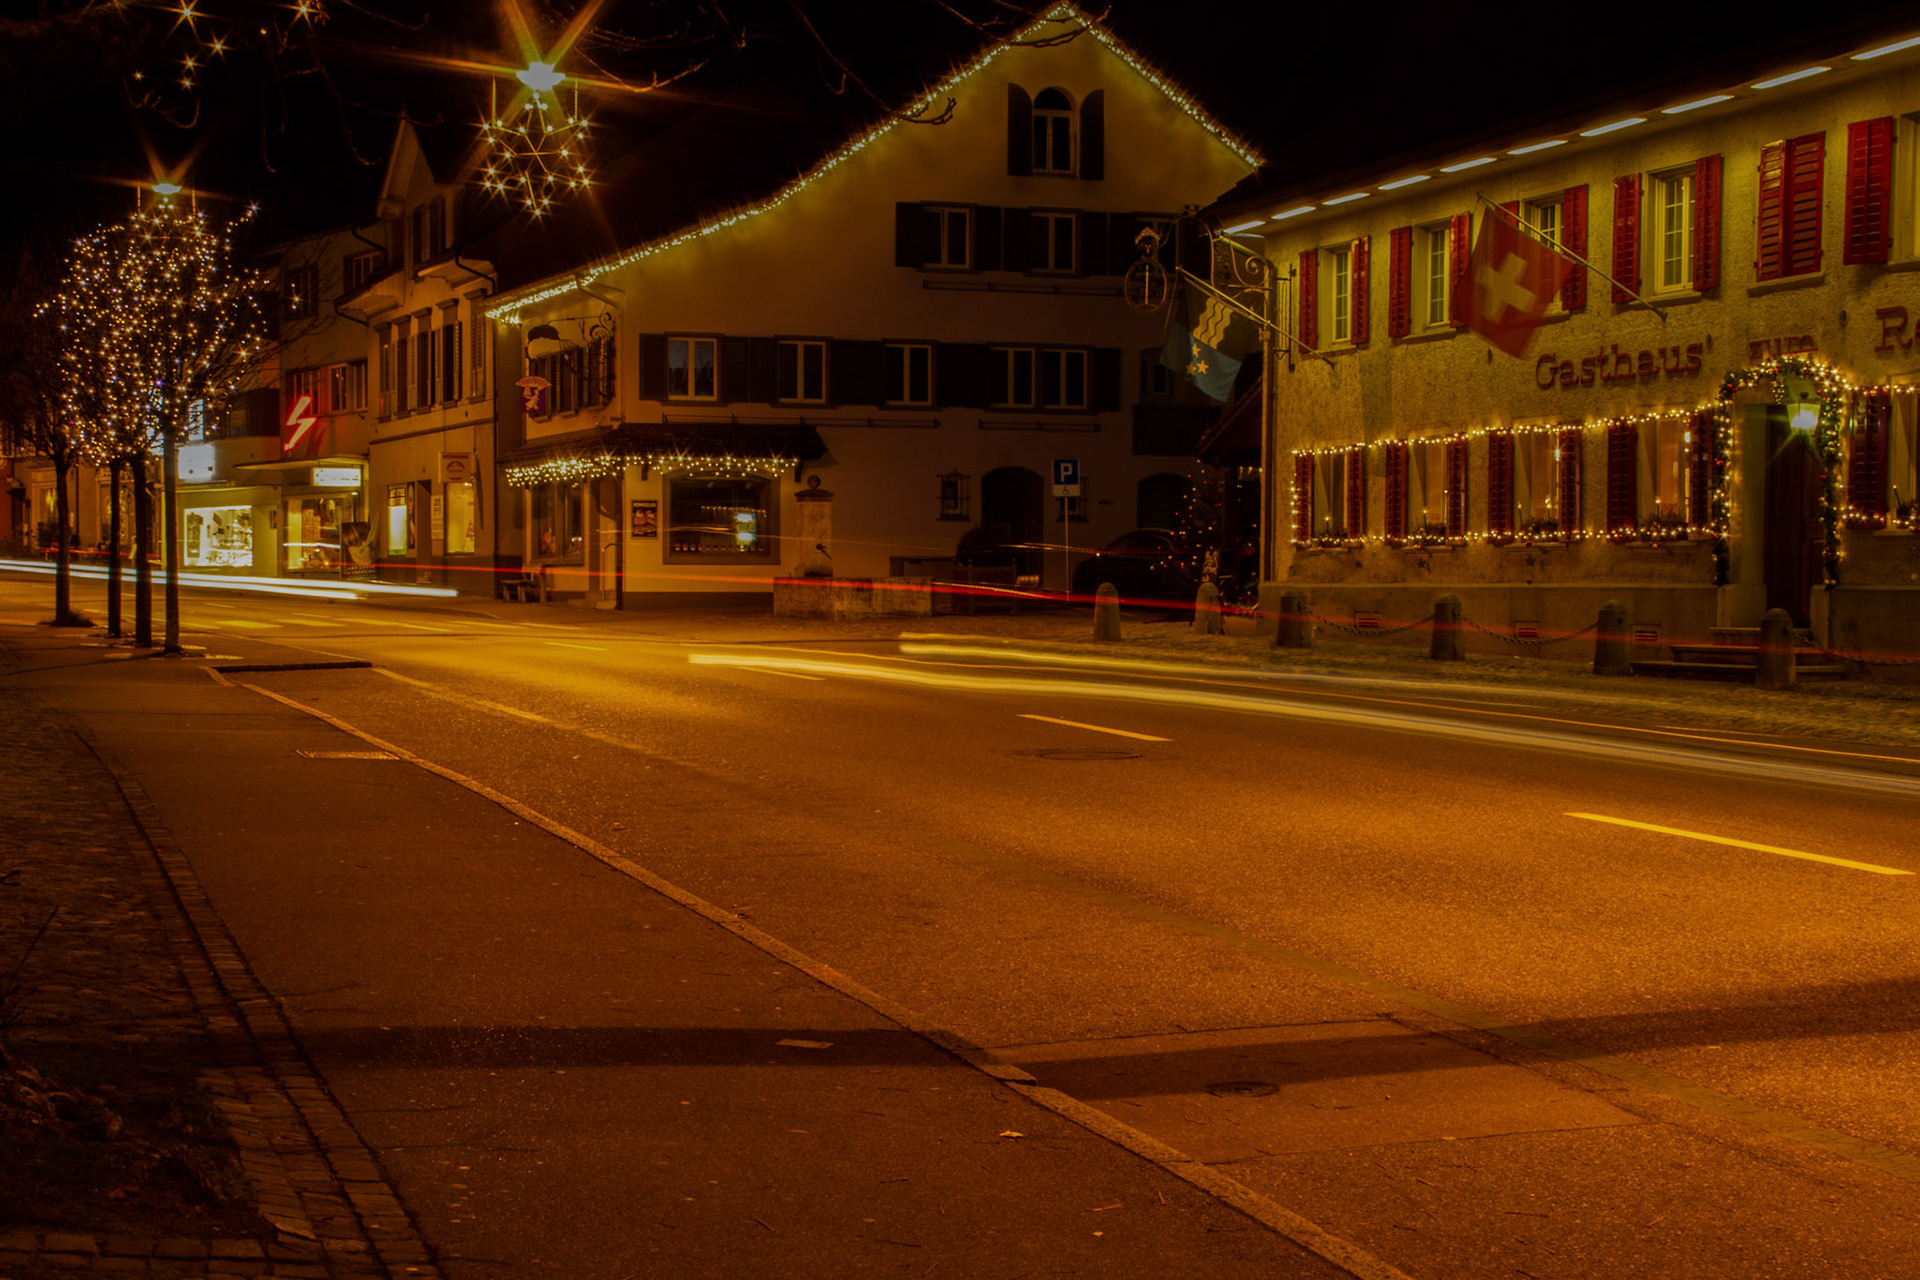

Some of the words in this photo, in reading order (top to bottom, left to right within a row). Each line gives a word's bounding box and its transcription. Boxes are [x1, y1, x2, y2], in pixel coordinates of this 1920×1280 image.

[1536, 341, 1703, 389] Gasthaus
[1749, 335, 1818, 360] zum
[1060, 462, 1073, 483] P
